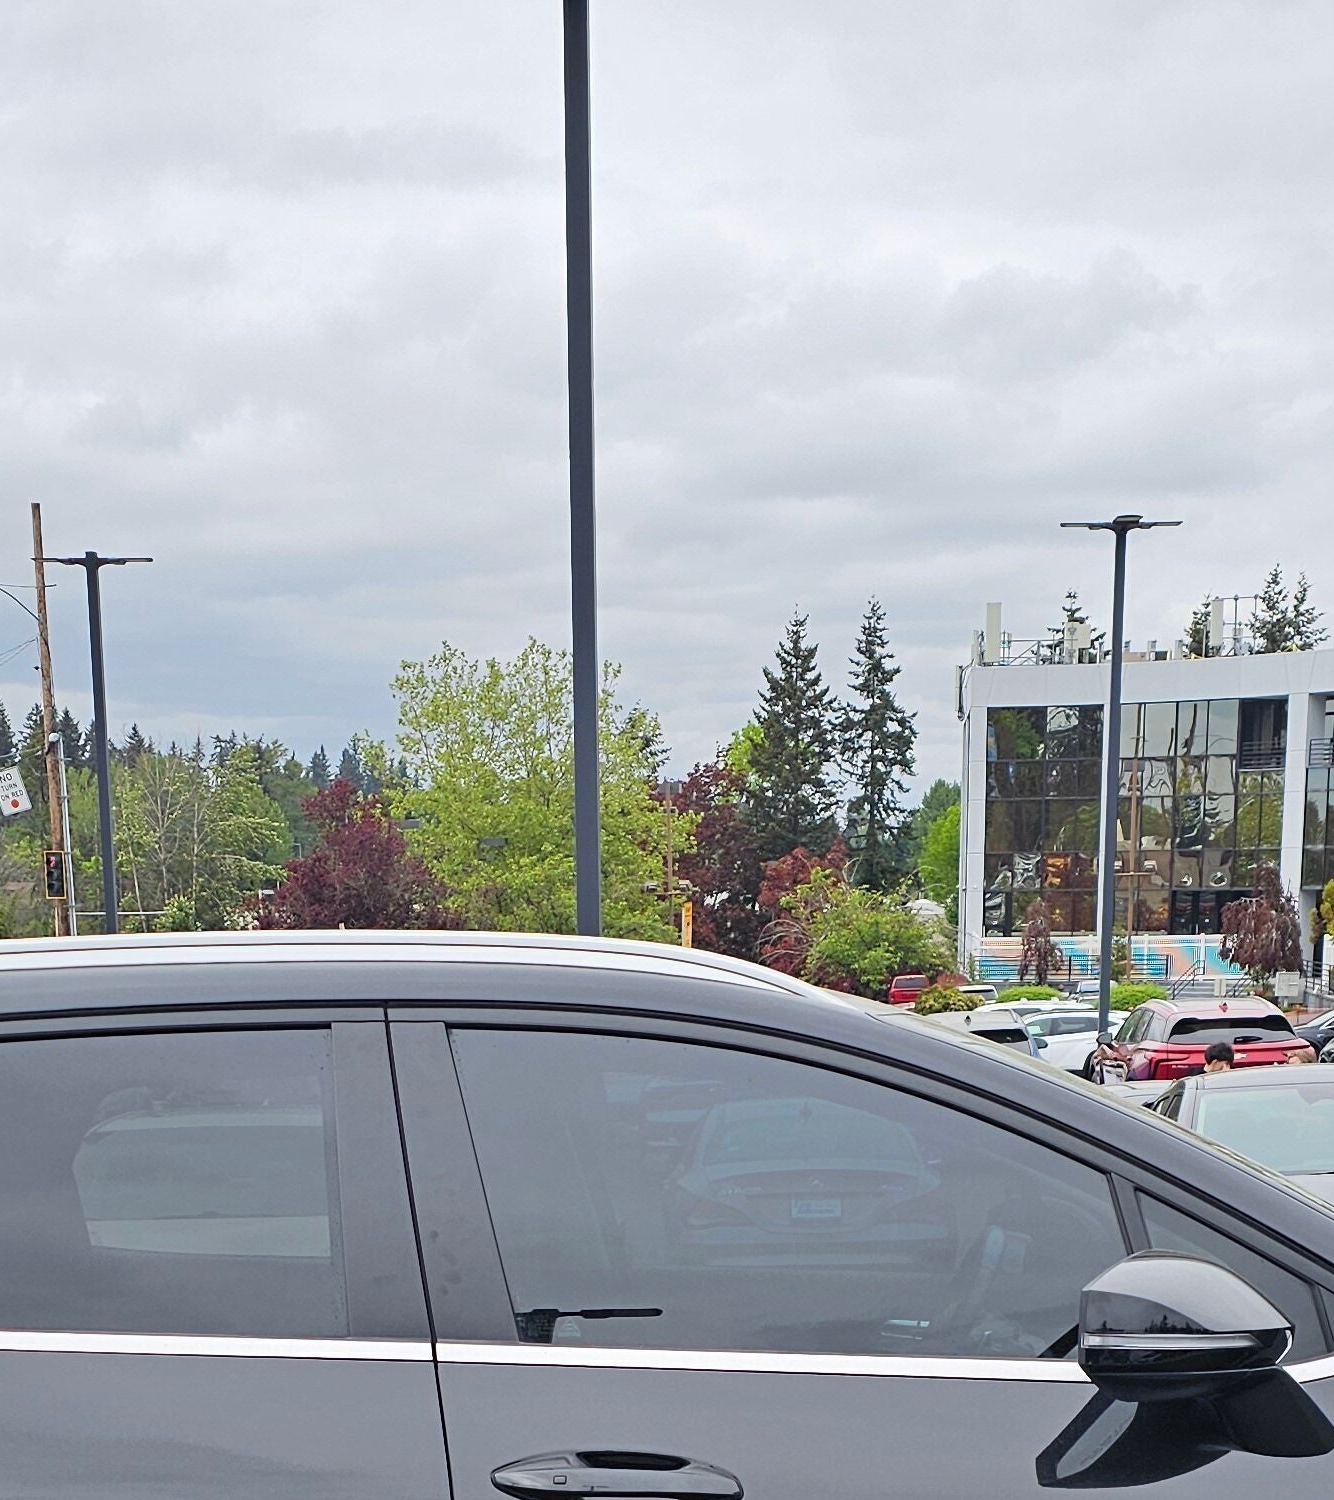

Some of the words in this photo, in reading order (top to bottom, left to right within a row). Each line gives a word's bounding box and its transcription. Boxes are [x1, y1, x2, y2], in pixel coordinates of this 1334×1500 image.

[0, 783, 18, 792] TURN
[0, 792, 10, 802] ON
[11, 789, 24, 798] RED
